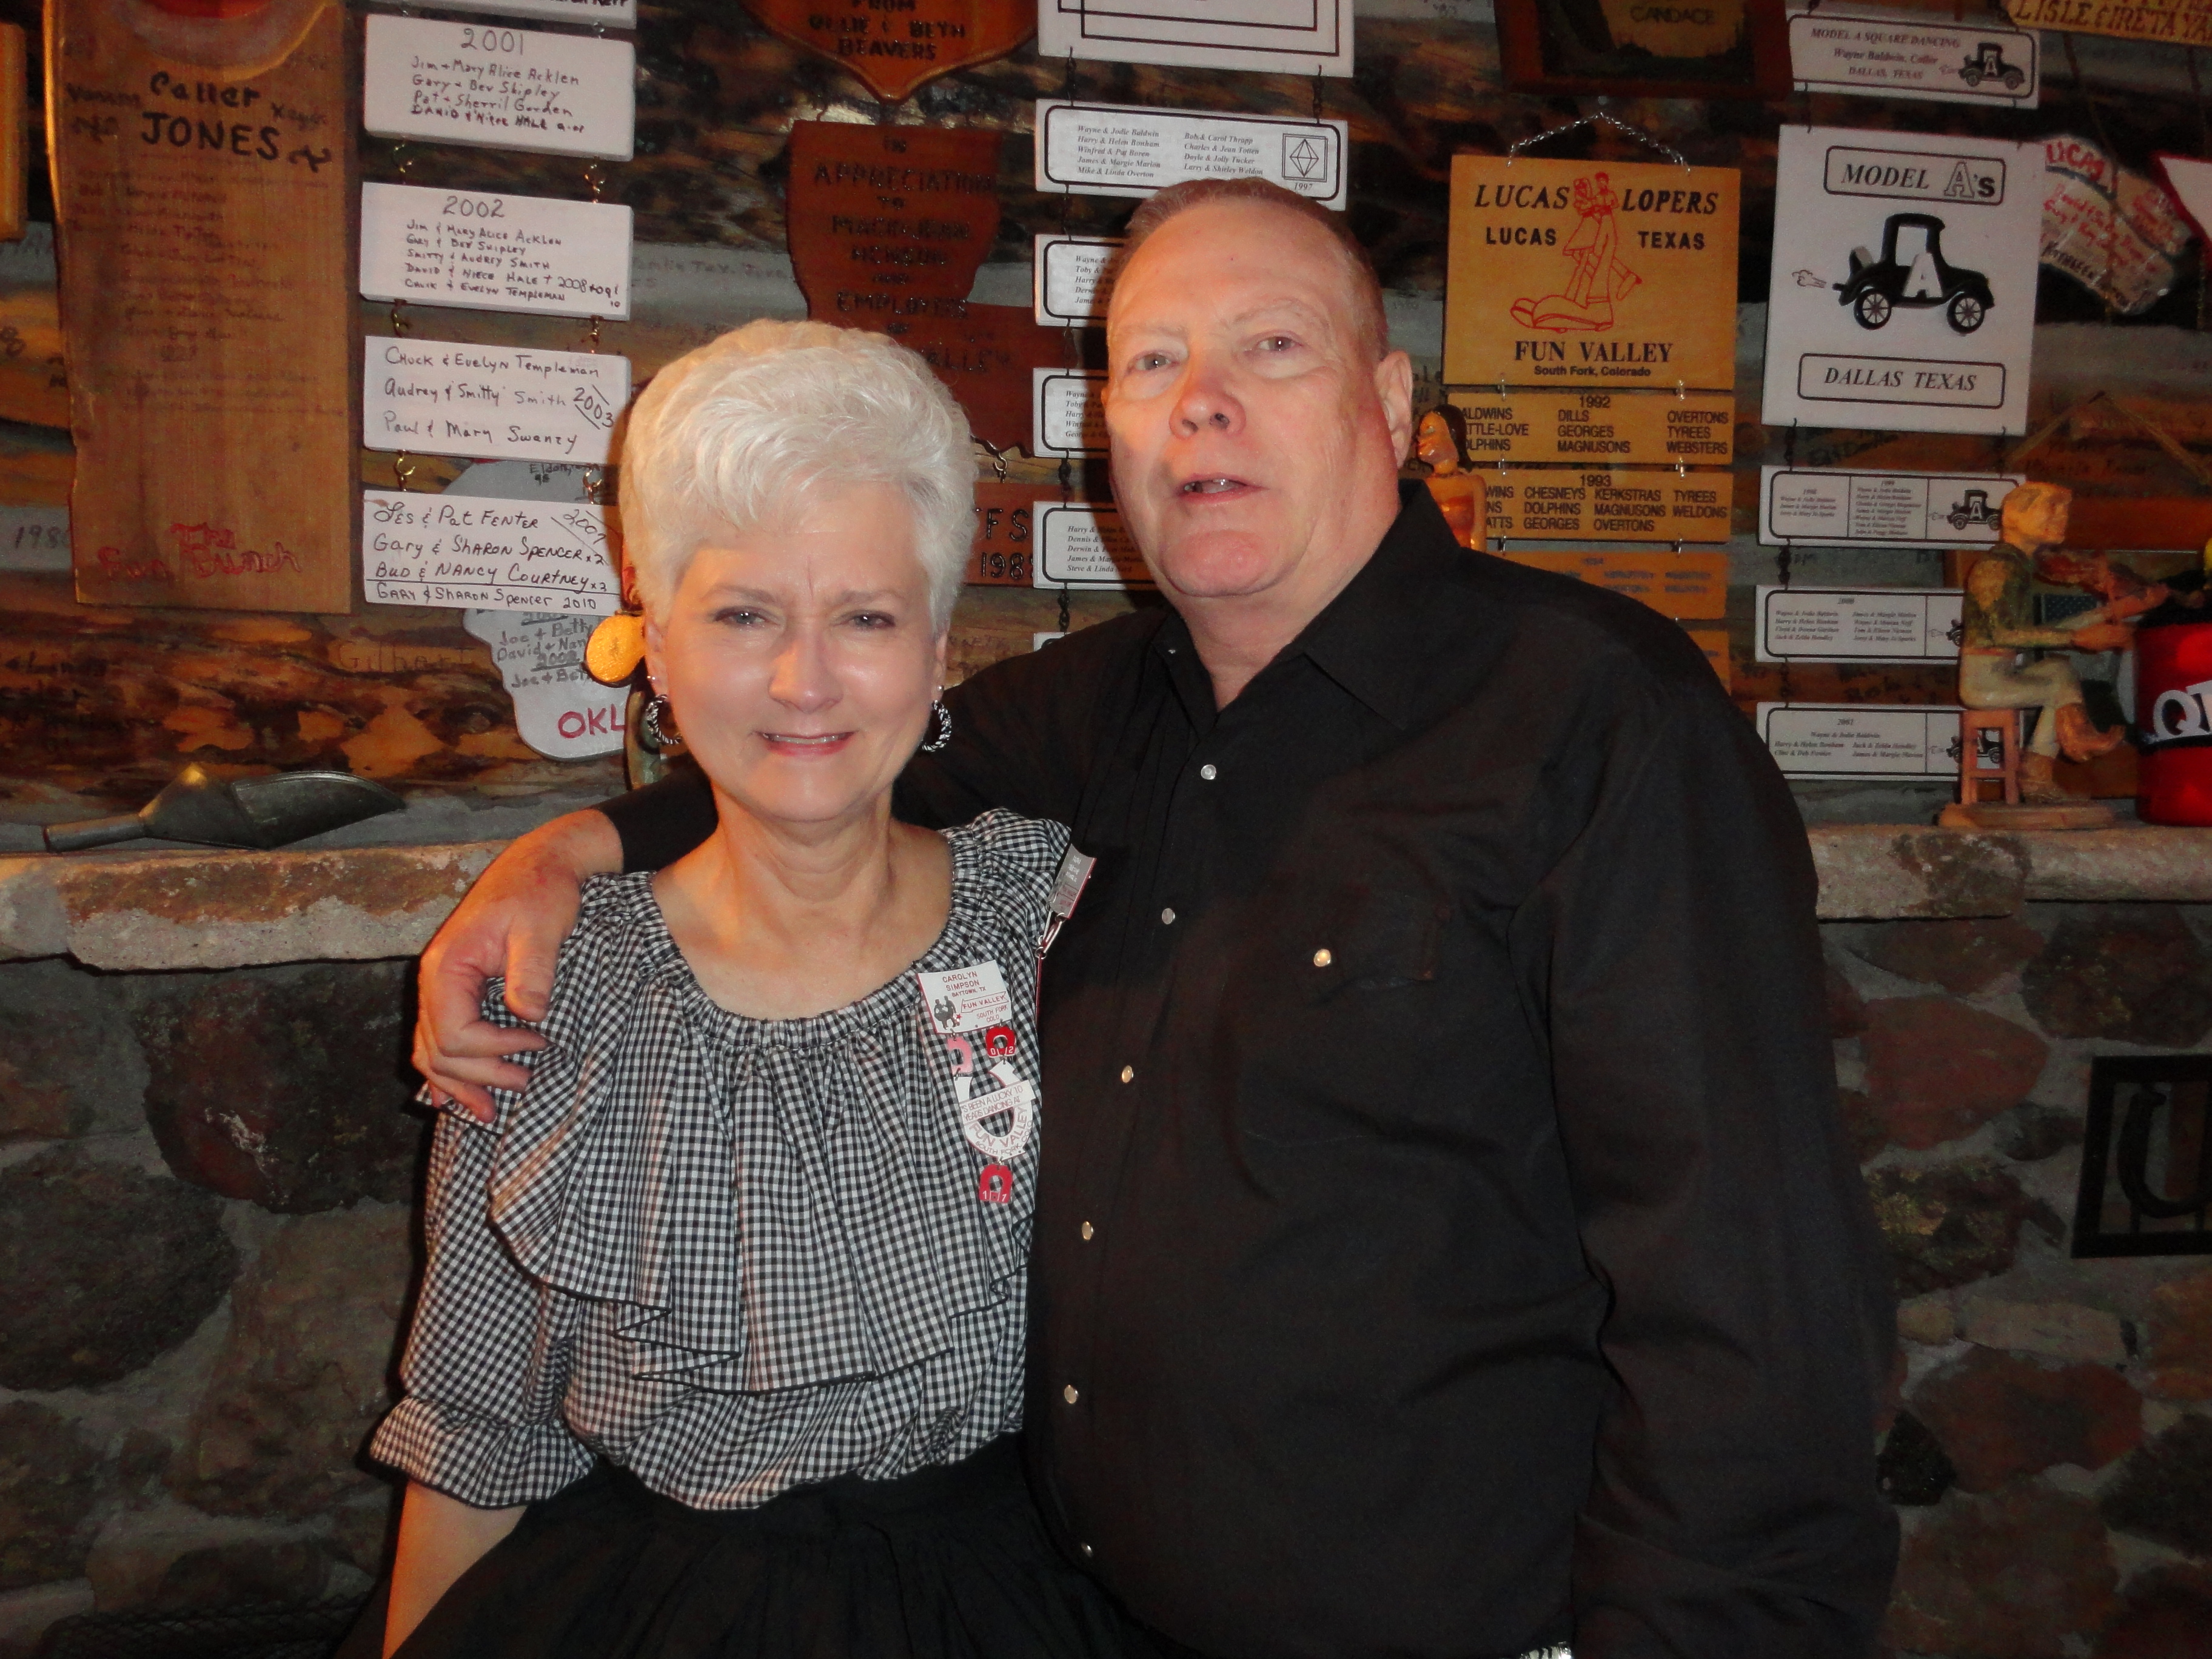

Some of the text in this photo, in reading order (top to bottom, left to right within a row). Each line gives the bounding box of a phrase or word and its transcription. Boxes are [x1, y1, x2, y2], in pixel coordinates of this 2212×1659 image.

[1630, 5, 1715, 25] CANDACE
[461, 27, 524, 55] 2001
[1811, 27, 1849, 39] MODEL
[1853, 32, 1861, 41] A
[1911, 35, 1961, 49] DANCING
[837, 36, 938, 61] BEAVERS
[412, 56, 438, 71] Jim
[453, 58, 484, 80] Mary
[489, 63, 521, 78] Alice
[1893, 69, 1923, 79] TEXAS
[150, 71, 261, 108] Caller
[412, 73, 561, 102] Gary Bev Shipley
[414, 89, 440, 105] Pat
[141, 112, 281, 161] JONES
[1078, 125, 1101, 133] Wayne
[1131, 129, 1159, 137] Baldwin
[1078, 135, 1098, 144] Harry
[1131, 139, 1160, 147] Bonham
[1184, 142, 1210, 151] Charles
[1078, 146, 1105, 155] Winfred
[1184, 153, 1204, 161] Doyle
[1110, 158, 1134, 167] Margie
[1184, 163, 1202, 172] Larry
[1213, 165, 1236, 174] Shirley
[1840, 163, 1929, 190] MODEL
[1293, 183, 1313, 191] 1997
[442, 195, 505, 219] 2002
[1474, 184, 1720, 215] LUCAS LOPERS
[1486, 226, 1706, 250] LUCAS TEXAS
[1075, 255, 1099, 265] Wayne
[1076, 265, 1091, 274] Toby
[557, 276, 588, 293] 2008
[1515, 340, 1674, 363] FUN VALLEY
[515, 354, 600, 379] Templeman
[1534, 365, 1567, 376] South
[1601, 366, 1651, 377] Colorado
[1824, 366, 1977, 392] DALLAS TEXAS
[384, 377, 566, 407] Audrey Smith
[572, 386, 615, 428] 2003
[1578, 395, 1612, 409] 1992
[1558, 410, 1729, 424] DILLS OVERTONS
[383, 411, 494, 444] Paul Mary
[1558, 424, 1712, 440] GEORGES TYREES
[1557, 440, 1728, 455] MAGNUSONS WEBSTERS
[1580, 474, 1612, 487] 1993
[1594, 489, 1662, 502] KERKSTRAS
[1674, 490, 1717, 504] TYREES
[1524, 502, 1728, 519] DOLPHINS MAGNUSONS WELDONS
[563, 508, 607, 545] 2007
[1067, 525, 1088, 534] Harry
[1523, 517, 1655, 532] GEORGES OVERTONS
[14, 524, 63, 549] 198
[373, 532, 424, 559] Gary
[435, 561, 498, 586] NANCY
[563, 596, 597, 609] 2010
[499, 630, 530, 646] Joe
[497, 641, 542, 662] David
[942, 971, 978, 983] CAROLYN
[946, 979, 980, 991] SIMPSON
[979, 995, 1004, 1005] VALLEY
[977, 1004, 1008, 1019] SOUTH FORK
[968, 1099, 986, 1111] BEEN
[993, 1088, 1014, 1102] LUCKY
[964, 1111, 984, 1122] YEARS
[984, 1099, 1013, 1115] DANCING
[969, 1107, 1028, 1148] FUN VALLEY
[975, 1141, 999, 1155] SOUTH
[1000, 1142, 1022, 1155] FORK
